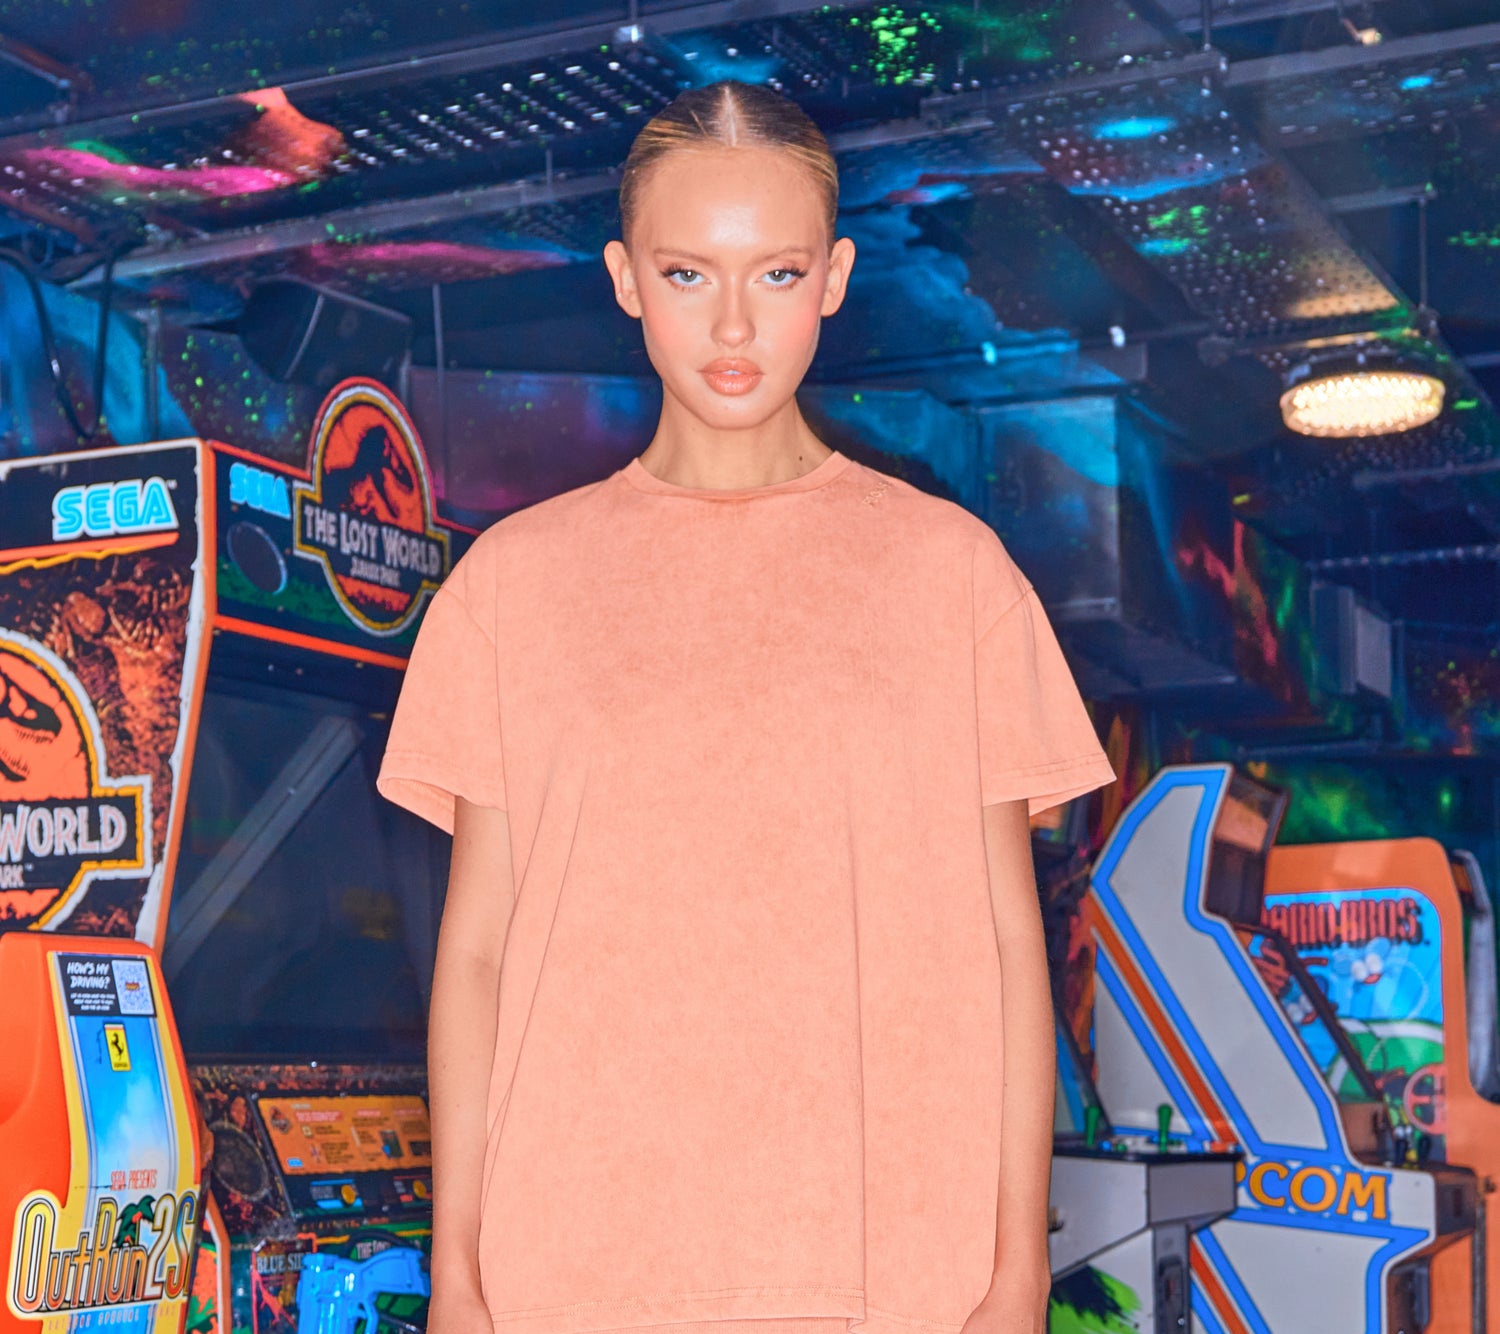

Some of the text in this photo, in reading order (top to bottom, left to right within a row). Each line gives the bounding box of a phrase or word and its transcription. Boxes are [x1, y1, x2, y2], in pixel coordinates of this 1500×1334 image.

[52, 476, 180, 542] SEGA
[304, 504, 441, 576] THE LOST WORLD
[0, 804, 127, 863] WORLD
[67, 961, 110, 976] HOW'S MY
[70, 975, 111, 989] DRIVING?
[110, 1168, 158, 1191] SEGA PRESENTS
[257, 1254, 285, 1275] BLUE
